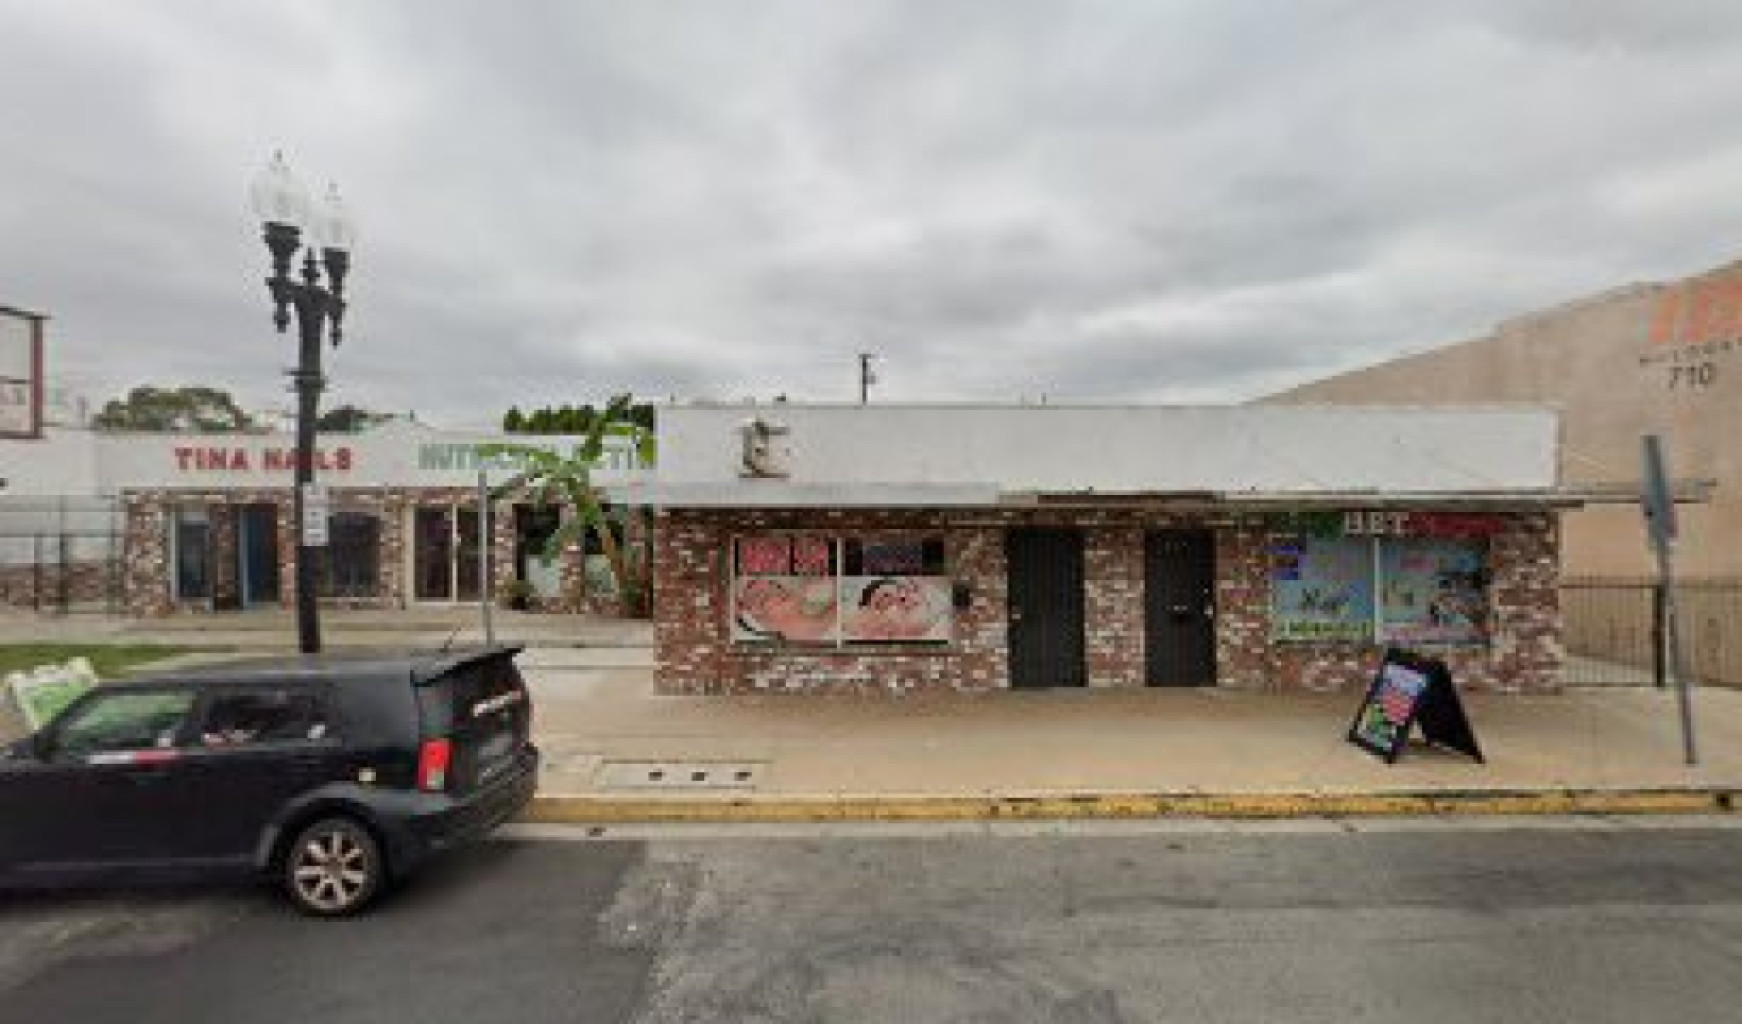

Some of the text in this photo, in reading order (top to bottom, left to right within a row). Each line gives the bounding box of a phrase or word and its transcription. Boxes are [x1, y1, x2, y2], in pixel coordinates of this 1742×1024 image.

[1667, 362, 1717, 391] 710
[175, 447, 352, 470] TINA NALS
